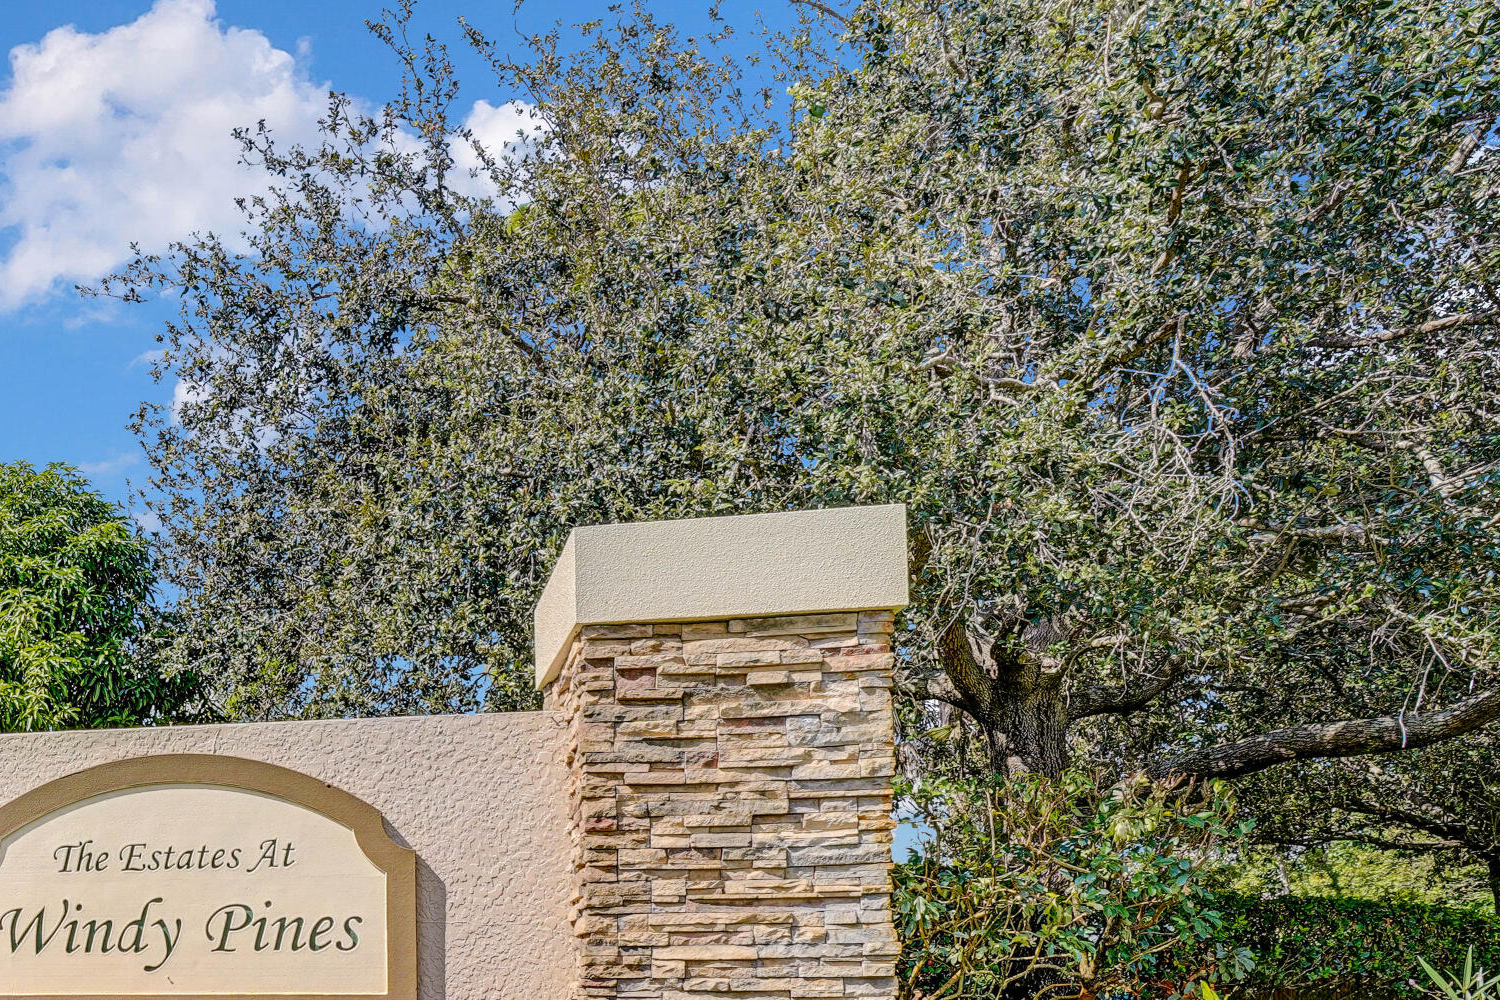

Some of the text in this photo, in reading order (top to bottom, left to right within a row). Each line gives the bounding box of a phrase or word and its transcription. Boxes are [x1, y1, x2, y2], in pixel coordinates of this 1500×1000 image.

[53, 838, 295, 873] The Estates At
[205, 900, 363, 953] Pines
